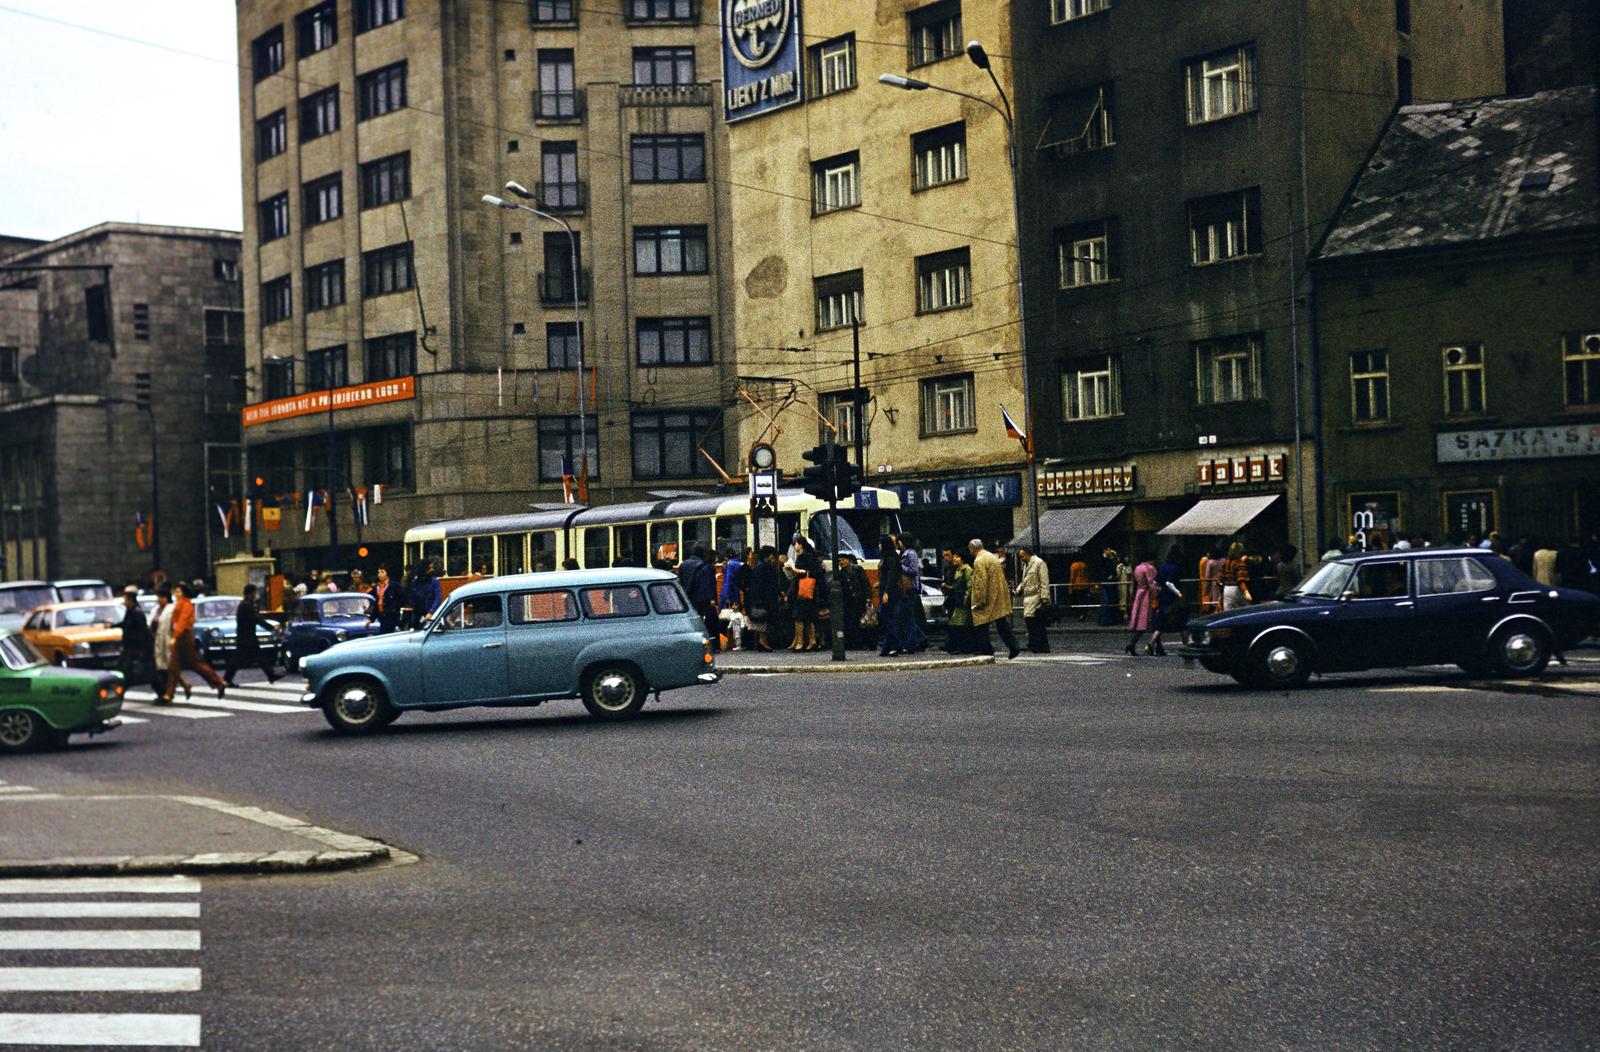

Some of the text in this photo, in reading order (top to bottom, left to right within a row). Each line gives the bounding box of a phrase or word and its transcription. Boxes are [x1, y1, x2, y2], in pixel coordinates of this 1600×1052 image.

[760, 79, 769, 100] Z
[311, 397, 316, 407] A
[1201, 459, 1281, 481] tabak
[907, 479, 1005, 505] EKÁREŇ
[1037, 474, 1131, 491] cukrovinky
[861, 492, 871, 507] 5
